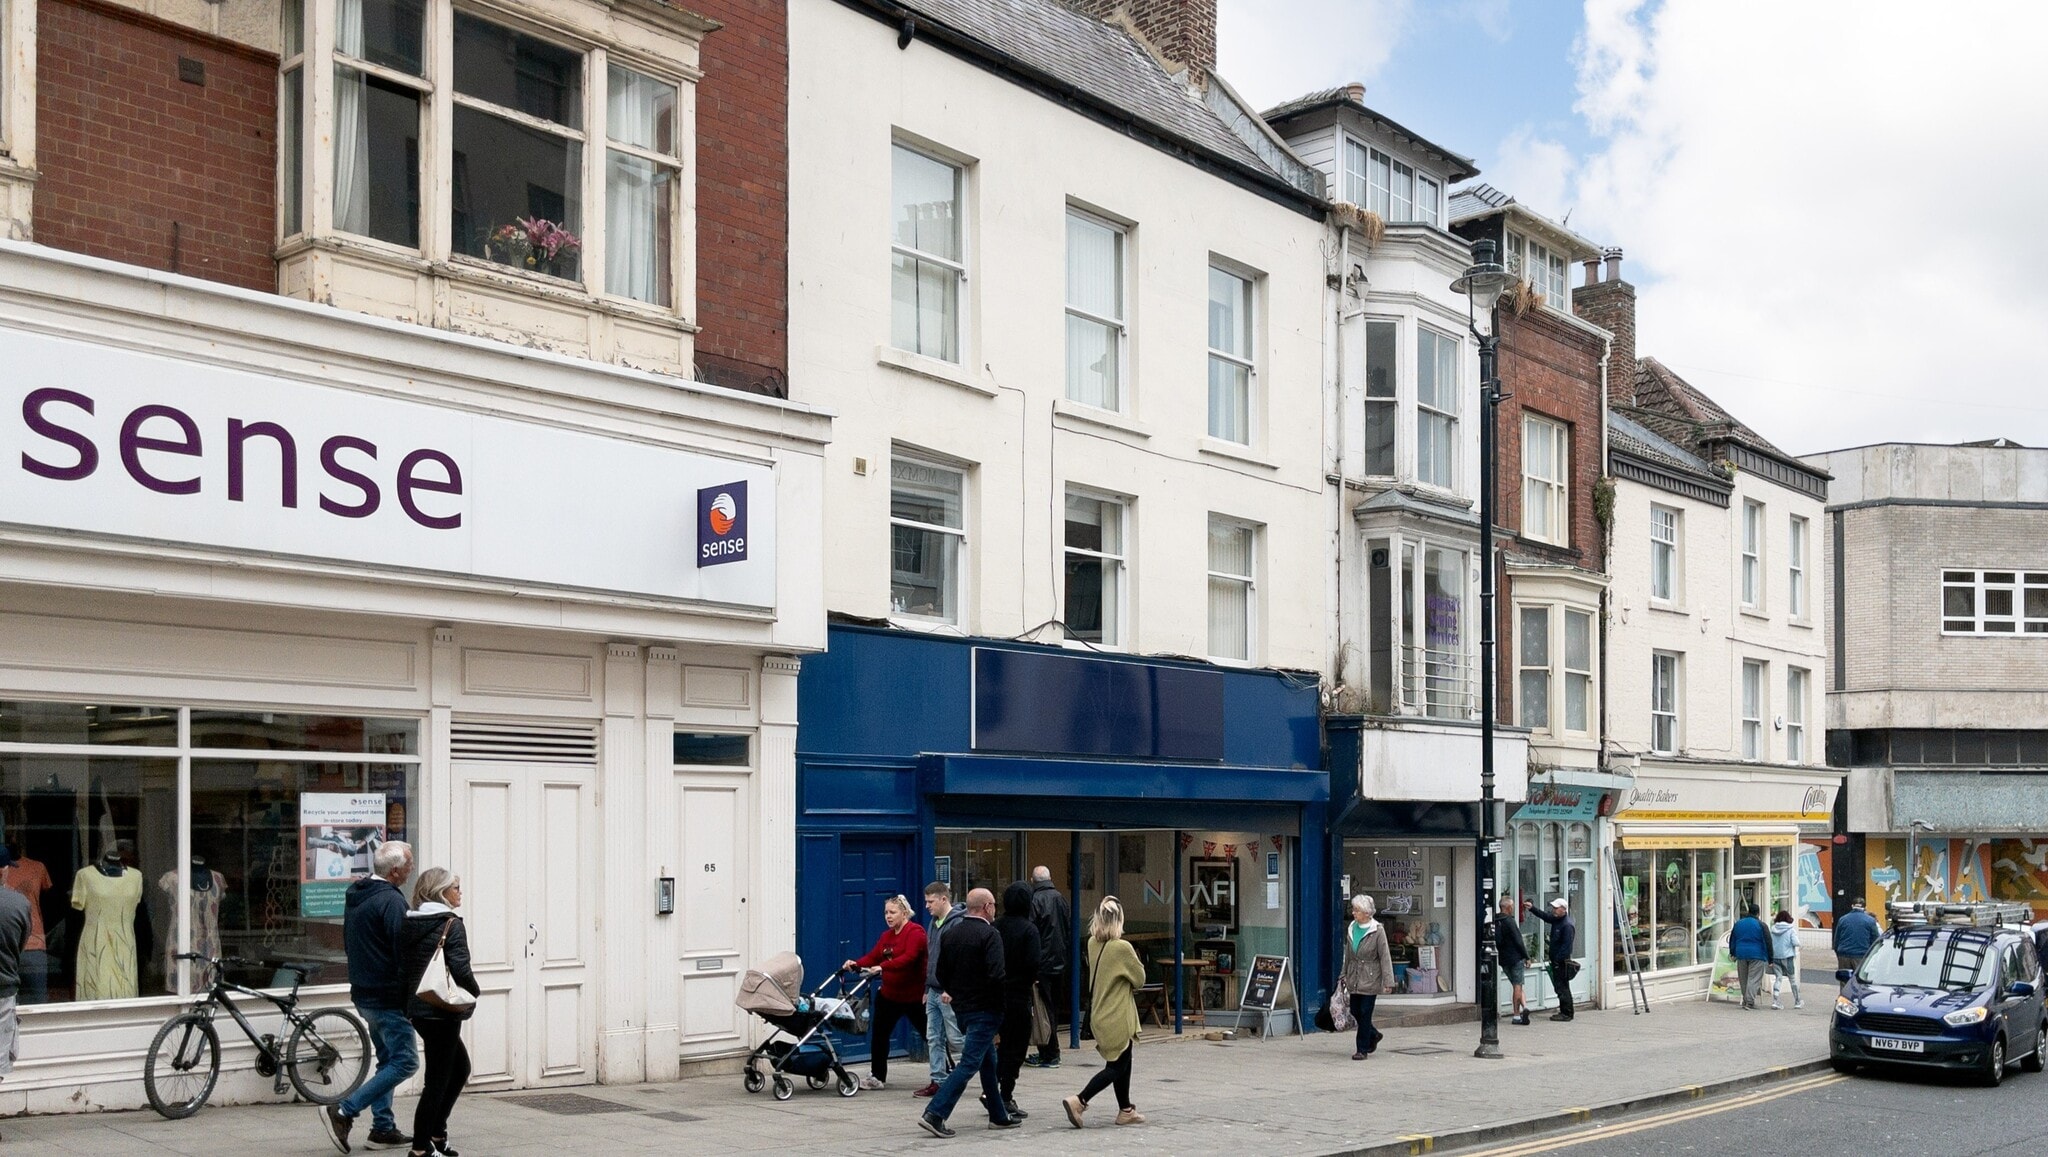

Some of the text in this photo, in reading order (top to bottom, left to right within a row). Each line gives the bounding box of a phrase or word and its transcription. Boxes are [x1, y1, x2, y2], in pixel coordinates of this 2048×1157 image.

[20, 387, 463, 530] sense
[702, 537, 745, 558] sense
[1430, 612, 1457, 630] Sewing
[1430, 628, 1459, 646] Services
[1630, 788, 1678, 805] Quality Bakers
[704, 863, 716, 872] 65
[1376, 858, 1417, 868] Vanessa's
[1380, 869, 1412, 879] Sewing
[1378, 880, 1415, 889] Services
[1875, 1039, 1920, 1050] NV67 BVP
